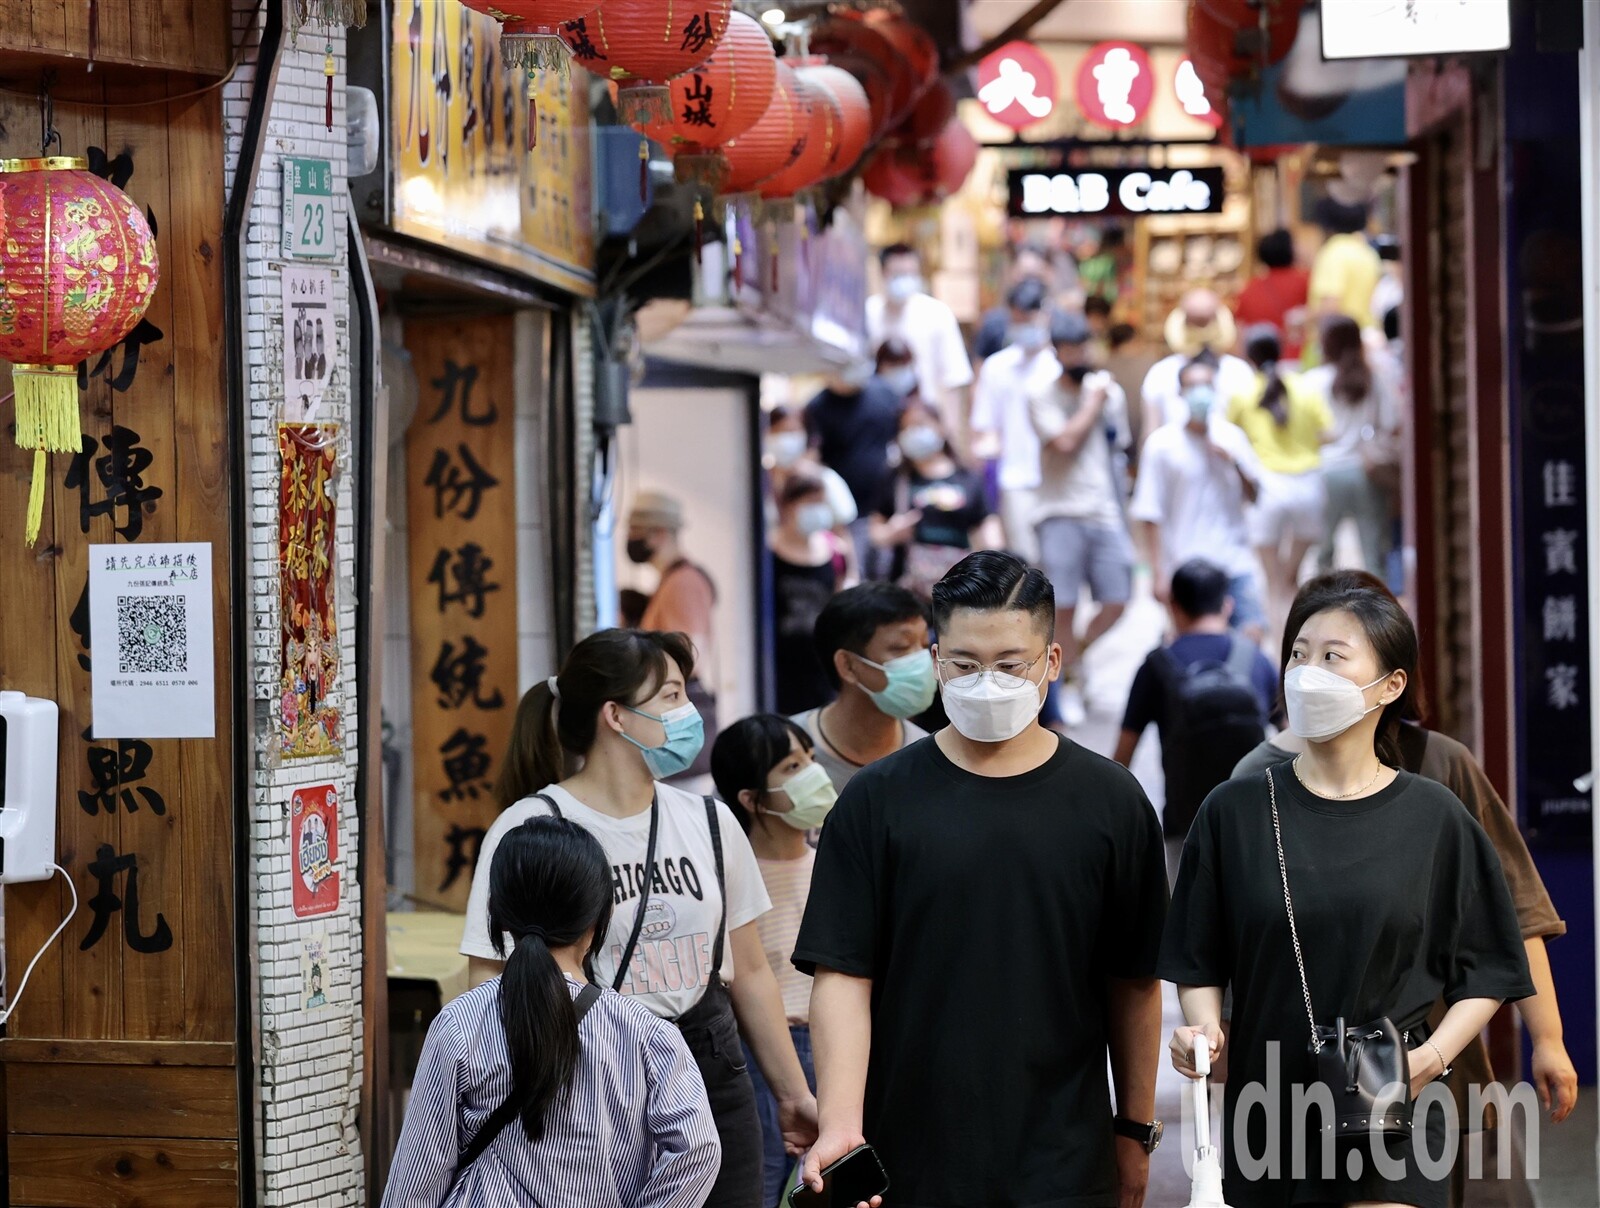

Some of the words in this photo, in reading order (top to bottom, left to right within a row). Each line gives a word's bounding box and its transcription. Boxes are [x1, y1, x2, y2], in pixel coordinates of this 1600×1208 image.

[681, 73, 717, 129] 山城
[1021, 173, 1110, 212] B&B
[1118, 169, 1211, 212] Cafe
[301, 203, 324, 246] 23
[613, 856, 704, 905] HICAGO
[610, 931, 711, 996] LEAGUE
